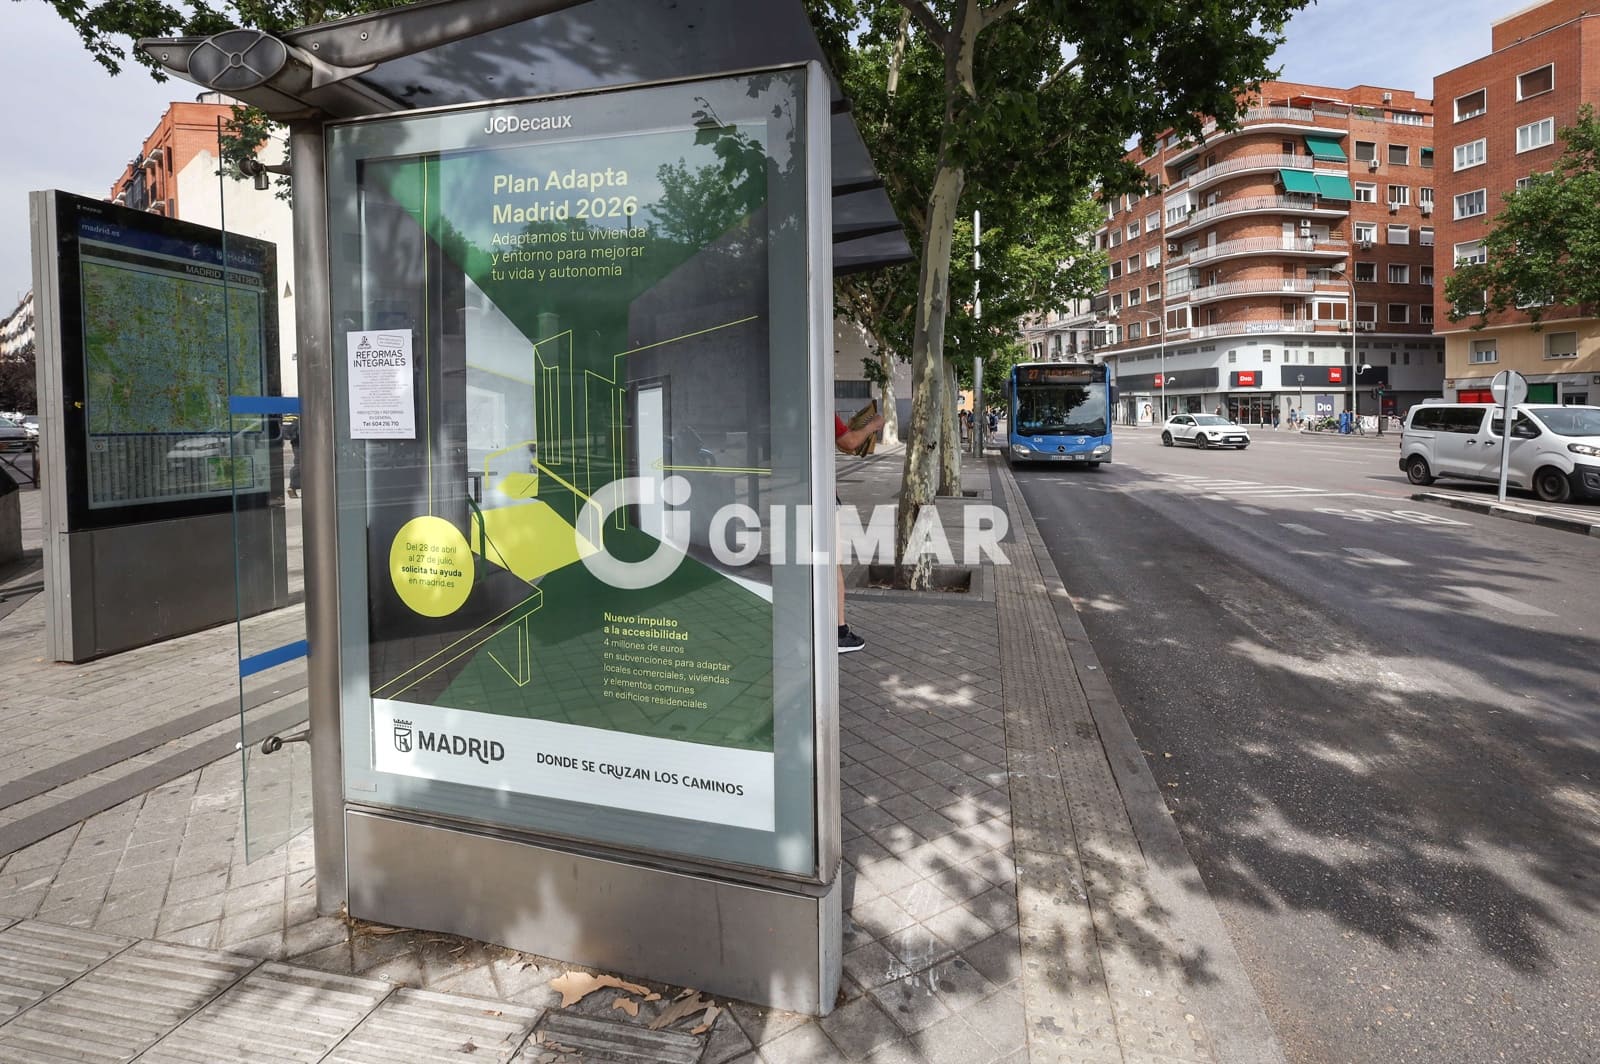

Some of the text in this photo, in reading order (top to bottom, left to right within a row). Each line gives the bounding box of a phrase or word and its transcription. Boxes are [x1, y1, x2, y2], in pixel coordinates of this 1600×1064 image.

[484, 115, 572, 134] JCDecaux
[493, 167, 628, 195] Plan Adapta
[492, 196, 638, 224] Madrid 2026
[81, 223, 120, 238] madrid.es
[491, 226, 646, 246] Adaptamos tu vivienda
[491, 245, 644, 265] y entorno para mejorar
[185, 264, 259, 286] MADRID ENTRO
[491, 263, 622, 281] tu vida y autonomía
[353, 358, 406, 368] INTEGRALES
[356, 349, 403, 359] REFORMAS
[1317, 403, 1332, 412] Dia
[1312, 507, 1473, 526] BUS
[406, 542, 457, 554] Del 28 de abril
[416, 555, 425, 563] 27
[401, 565, 428, 574] solicita
[439, 568, 462, 577] ayuda
[419, 579, 454, 588] madrid.es
[604, 612, 678, 628] Nuevo impulso
[611, 625, 620, 635] la
[622, 627, 688, 641] accesibilidad
[603, 638, 684, 654] 4 millones de euros
[603, 651, 730, 671] en subvenciones para adaptar
[603, 664, 730, 685] locales comerciales, viviendas
[603, 677, 695, 695] y elementos comunes
[615, 691, 650, 703] edificios
[651, 696, 708, 709] residenciales
[417, 730, 505, 764] MADRID
[536, 752, 744, 796] DONDE SE CRUZAN LOS CAMINOS
